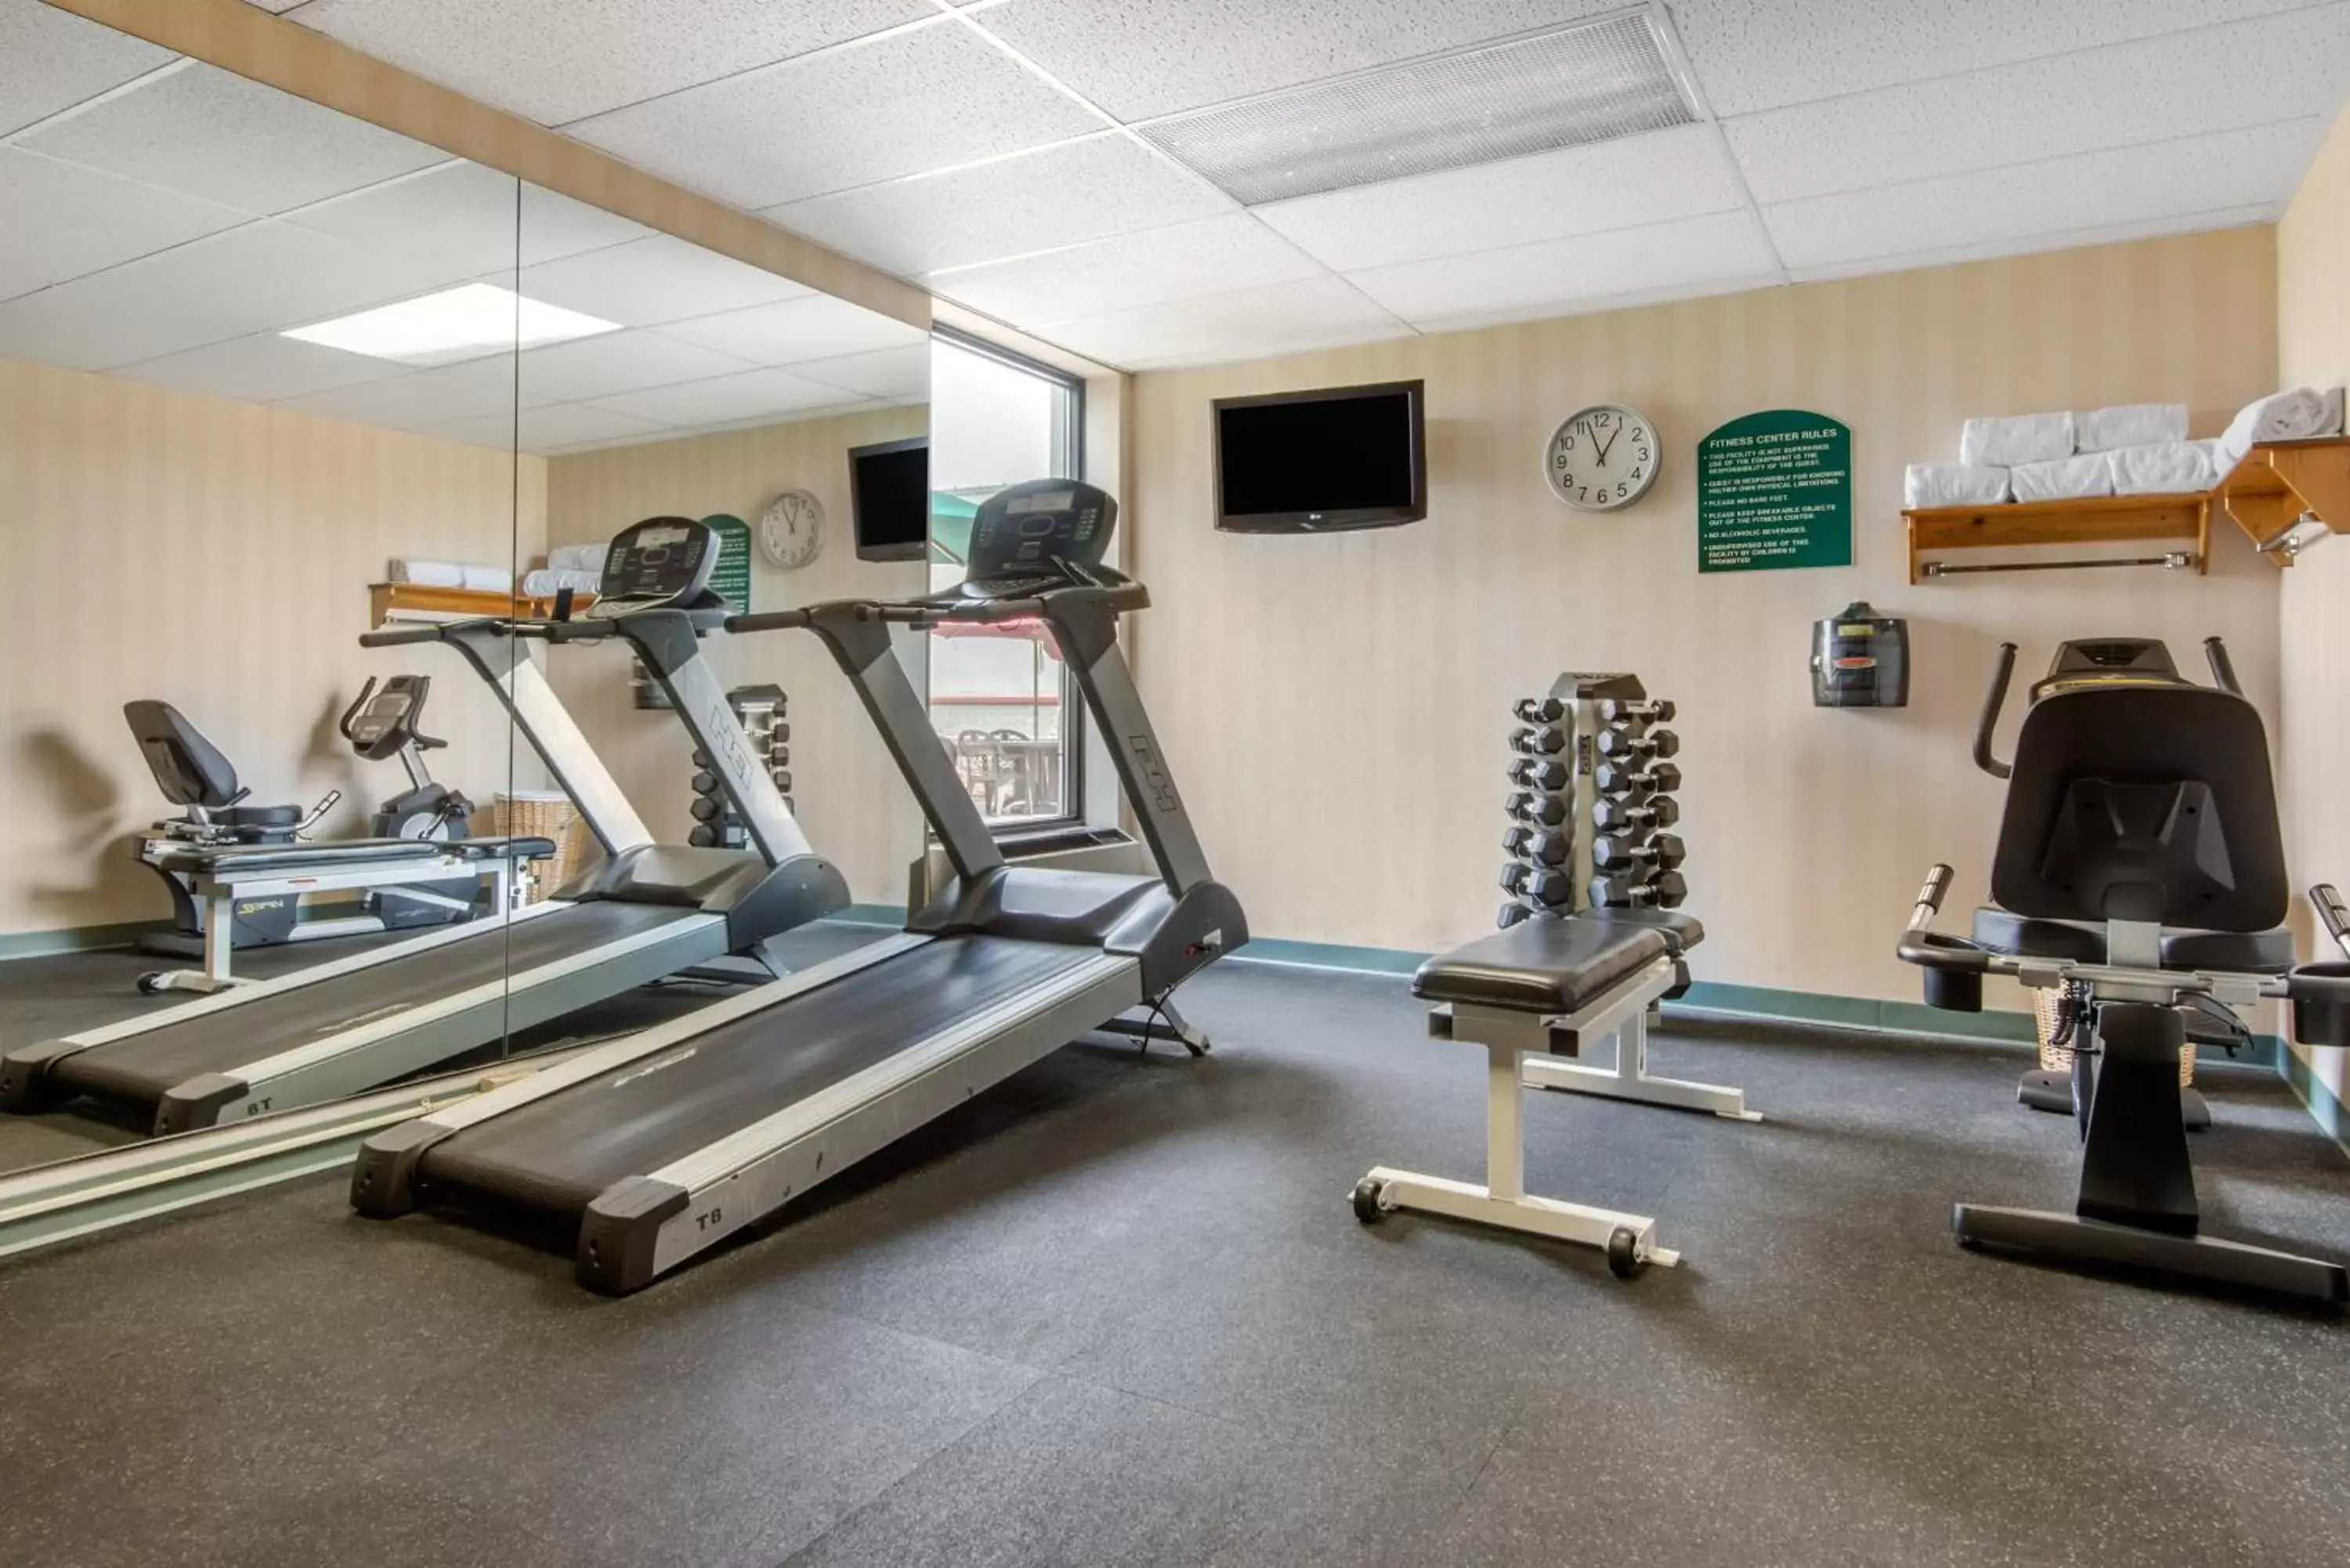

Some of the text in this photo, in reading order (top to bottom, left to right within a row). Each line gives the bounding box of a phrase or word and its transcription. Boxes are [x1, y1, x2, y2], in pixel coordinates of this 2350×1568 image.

[1576, 421, 1585, 435] 11
[1594, 413, 1610, 428] 12
[1631, 427, 1642, 443] 2
[1710, 428, 1837, 448] FITNESS CENTER RULES
[1560, 435, 1574, 451] 10
[1638, 447, 1648, 461] 3
[1751, 454, 1791, 464] EQUIPMENT
[1557, 455, 1567, 469] 9
[1563, 473, 1573, 488] 8
[1631, 467, 1641, 479] 4
[1578, 486, 1588, 501] 7
[1617, 482, 1627, 497] 5
[1757, 482, 1791, 491] PHYSICAL
[1597, 488, 1607, 503] 6
[1720, 529, 1761, 538] ALCOHOLIC
